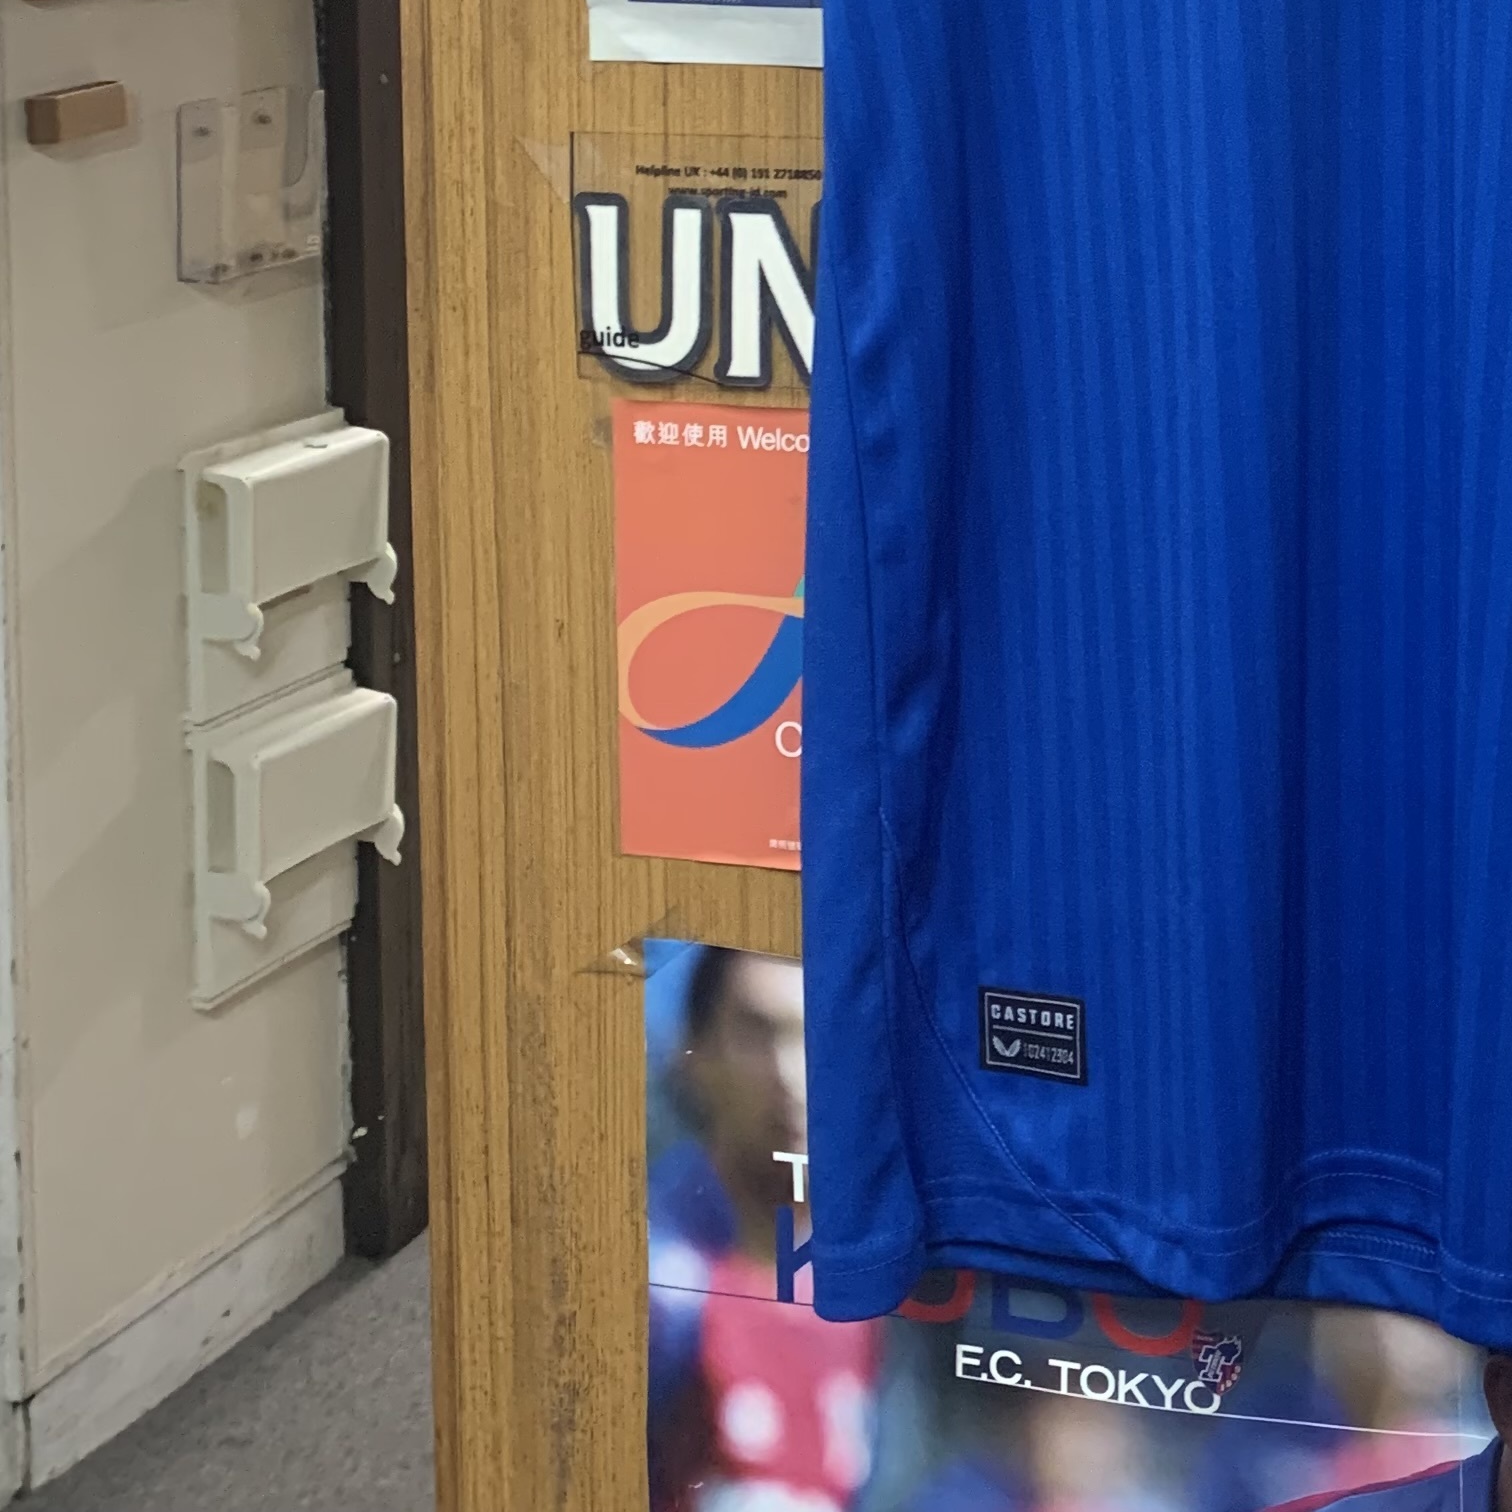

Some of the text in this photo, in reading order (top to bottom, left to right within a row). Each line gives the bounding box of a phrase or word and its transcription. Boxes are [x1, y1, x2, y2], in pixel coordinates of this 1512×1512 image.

[635, 165, 681, 178] Helpline
[684, 166, 701, 177] UK
[709, 167, 730, 177] +44
[579, 325, 640, 351] guide
[633, 420, 728, 448] 歡迎使用
[990, 1003, 1075, 1030] CASTORE
[955, 1343, 1032, 1388] F.C.
[1048, 1358, 1221, 1415] TOKYO
